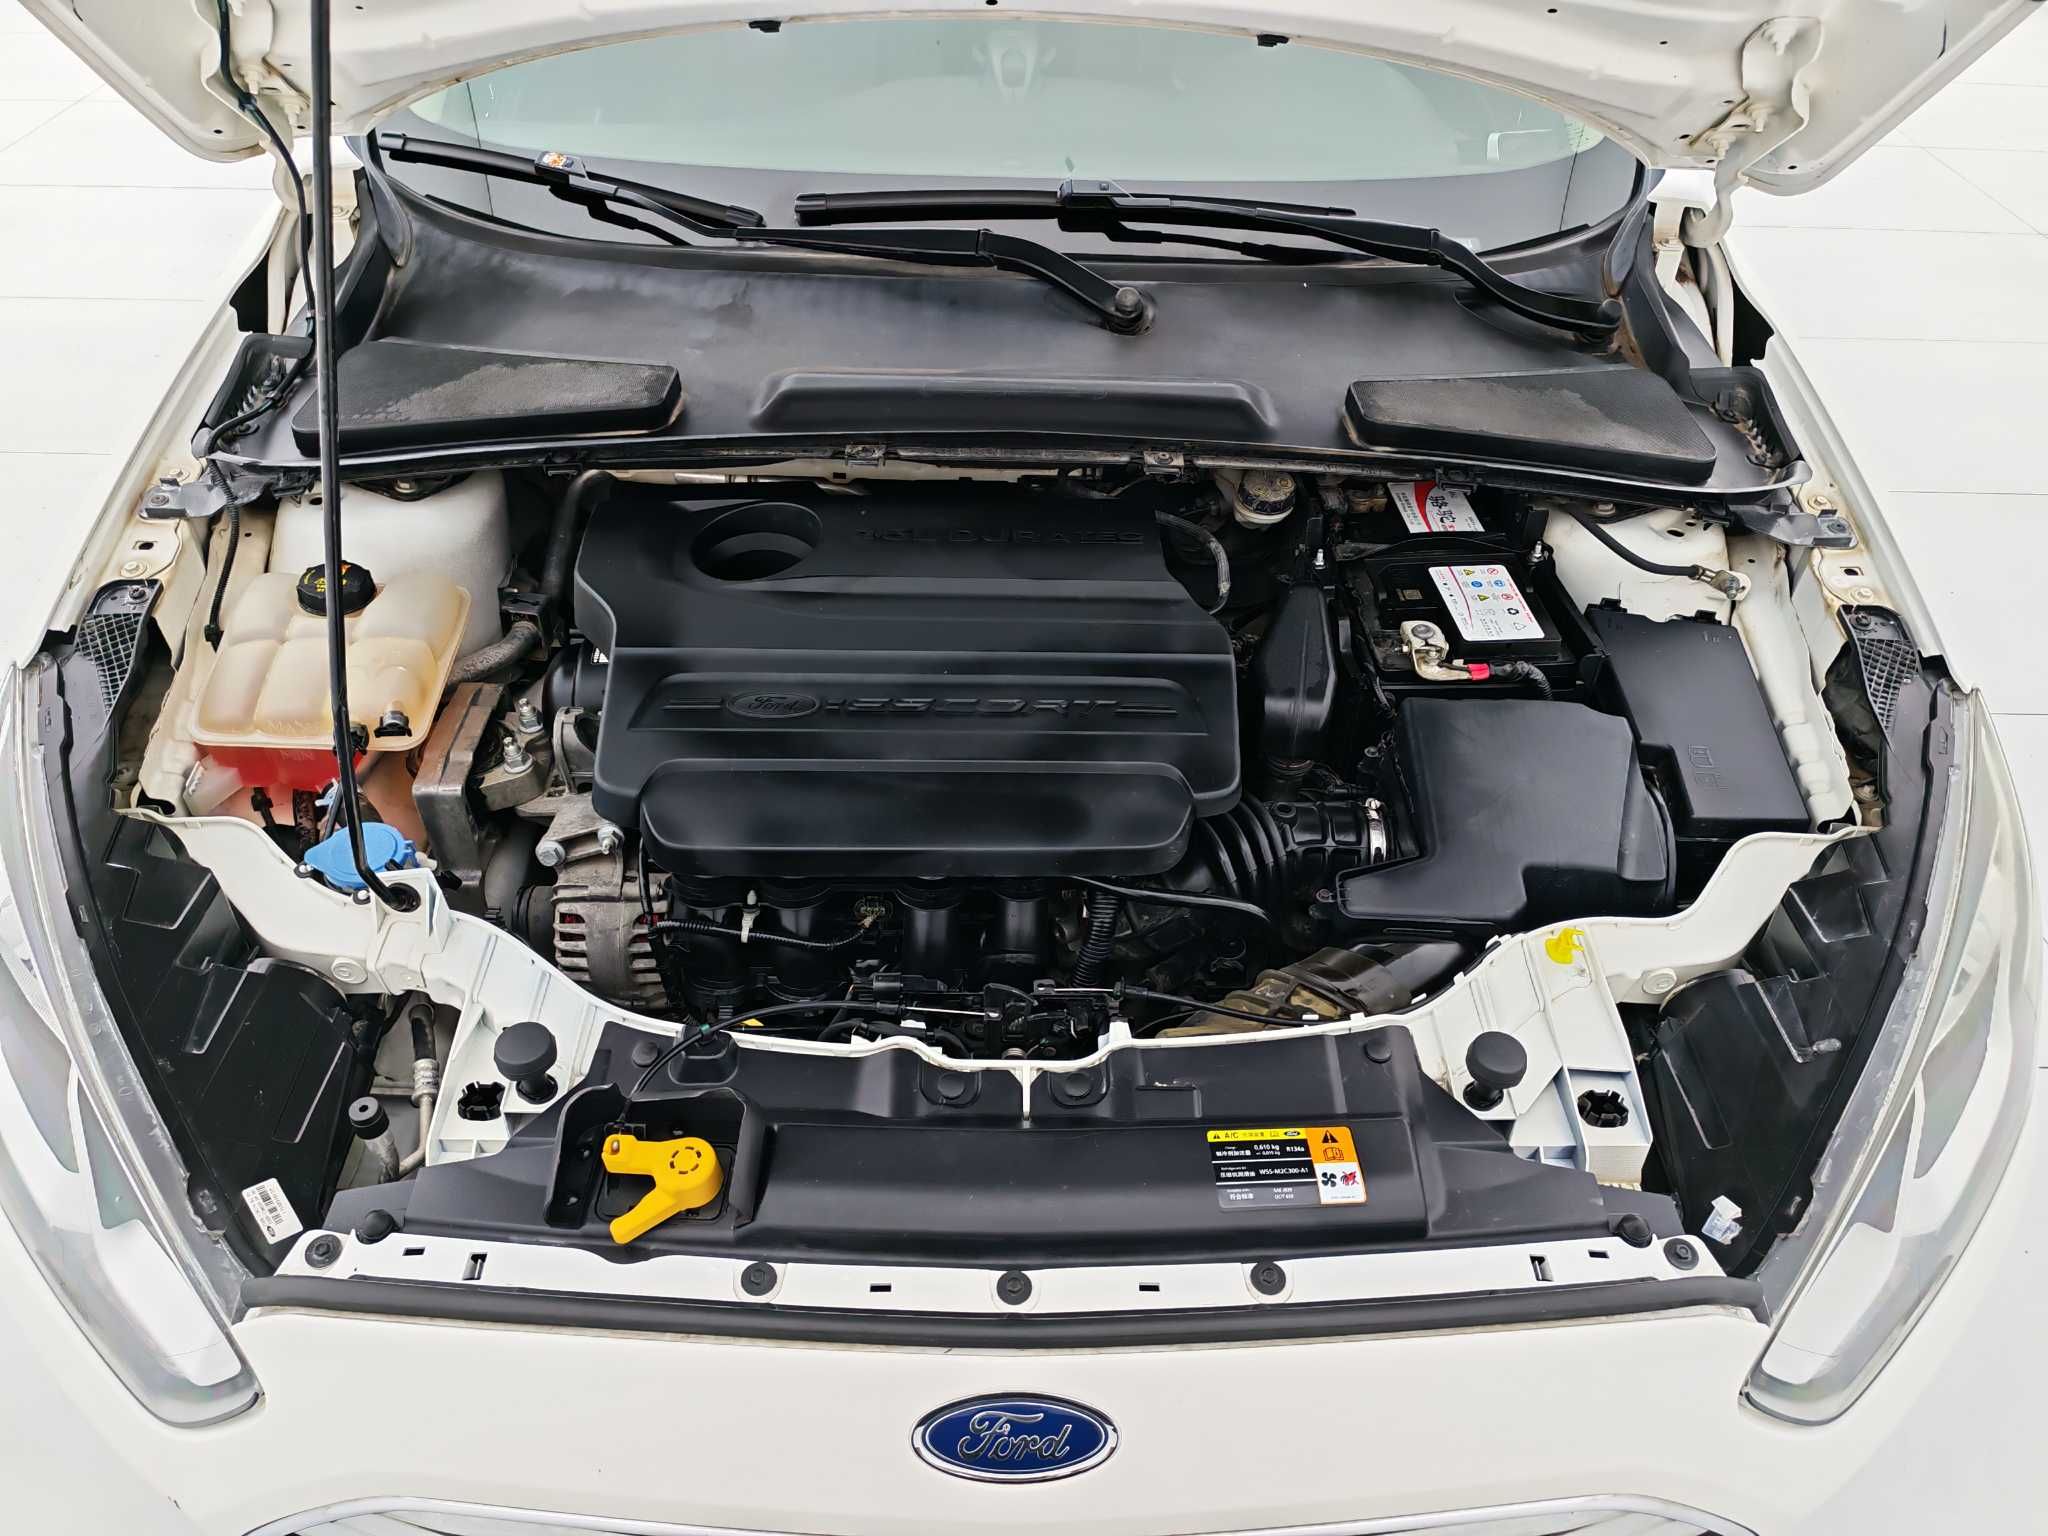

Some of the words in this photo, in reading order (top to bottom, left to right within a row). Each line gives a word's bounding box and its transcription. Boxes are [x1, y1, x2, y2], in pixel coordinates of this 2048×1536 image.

[748, 696, 796, 712] Ford
[848, 697, 1118, 713] ESCORT
[957, 1410, 1073, 1461] Ford
